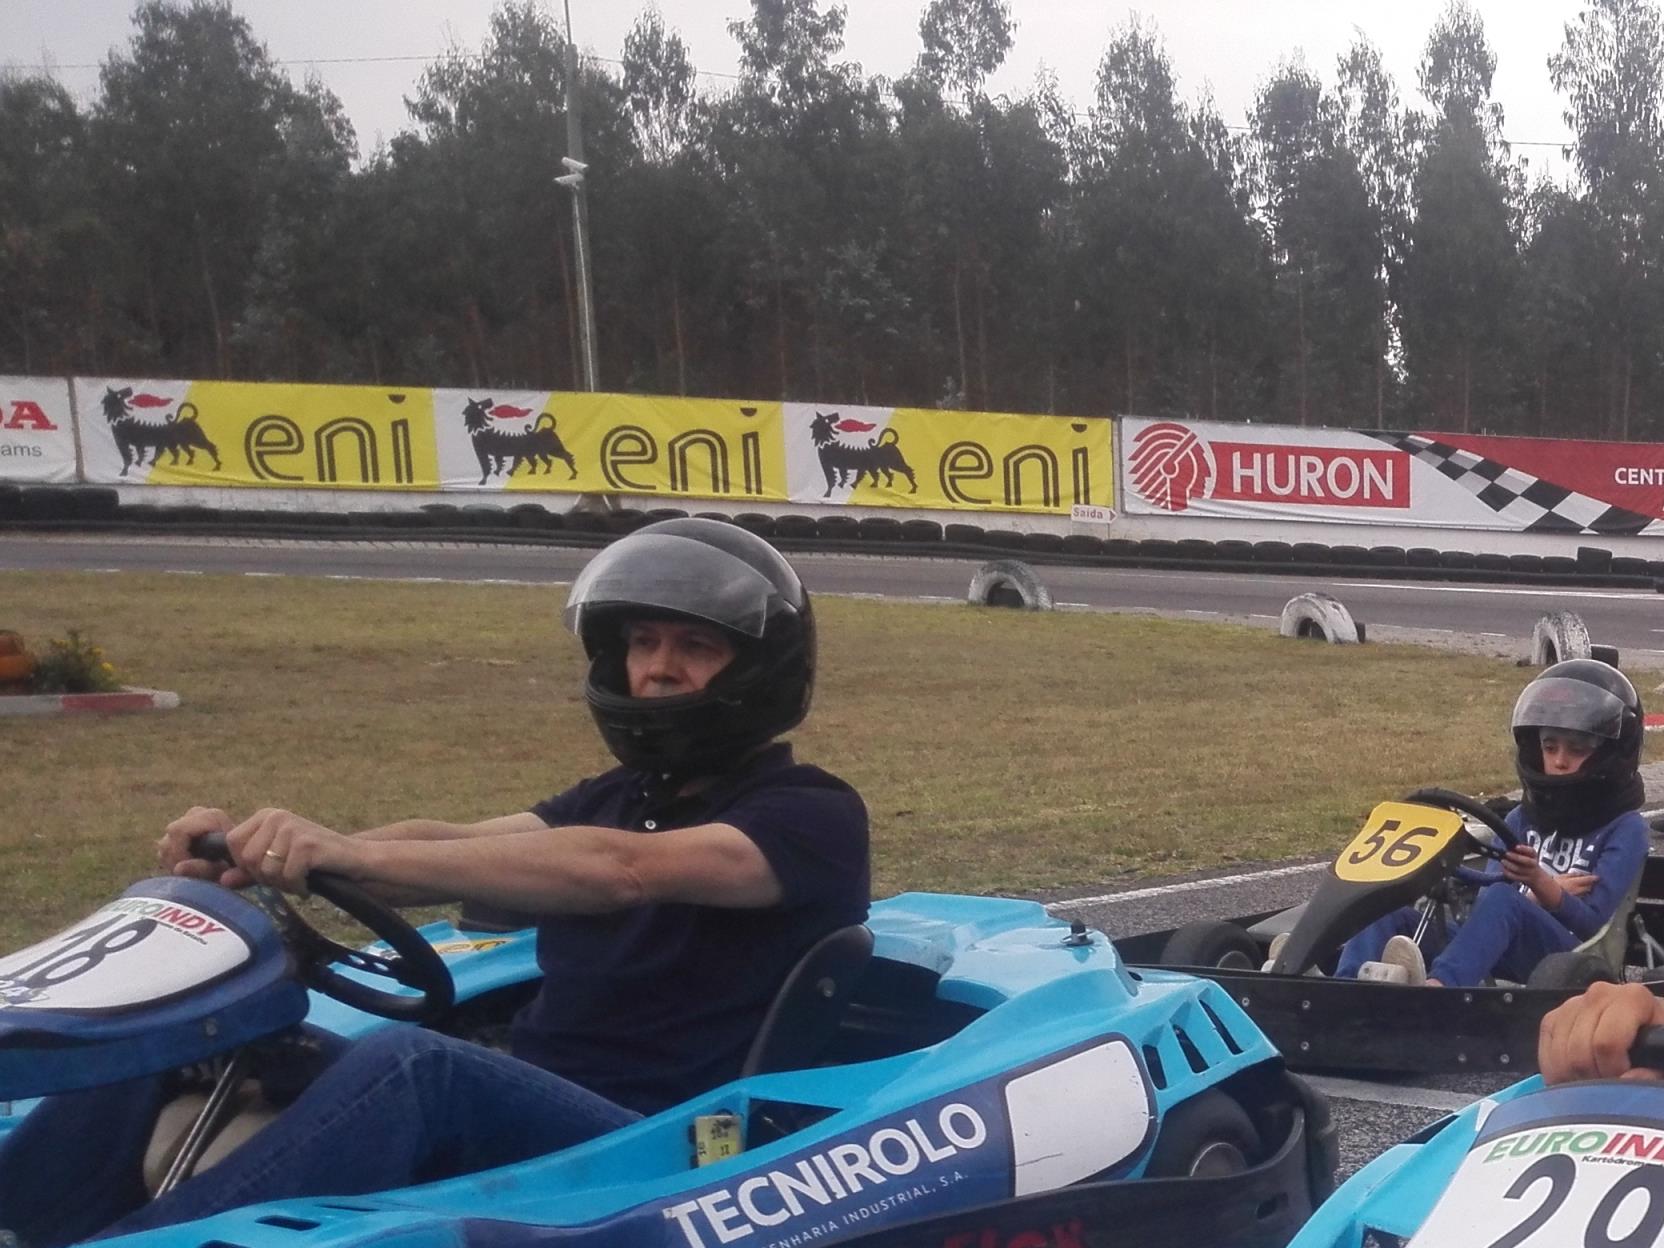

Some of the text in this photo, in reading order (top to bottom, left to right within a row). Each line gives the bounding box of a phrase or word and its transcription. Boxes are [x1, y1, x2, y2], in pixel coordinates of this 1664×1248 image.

[245, 394, 413, 485] eni
[600, 408, 763, 496] eni
[939, 424, 1091, 507] eni
[1232, 451, 1393, 500] HURON
[1349, 819, 1440, 867] 56
[0, 914, 159, 989] 18
[1581, 1155, 1648, 1168] Kartódrom
